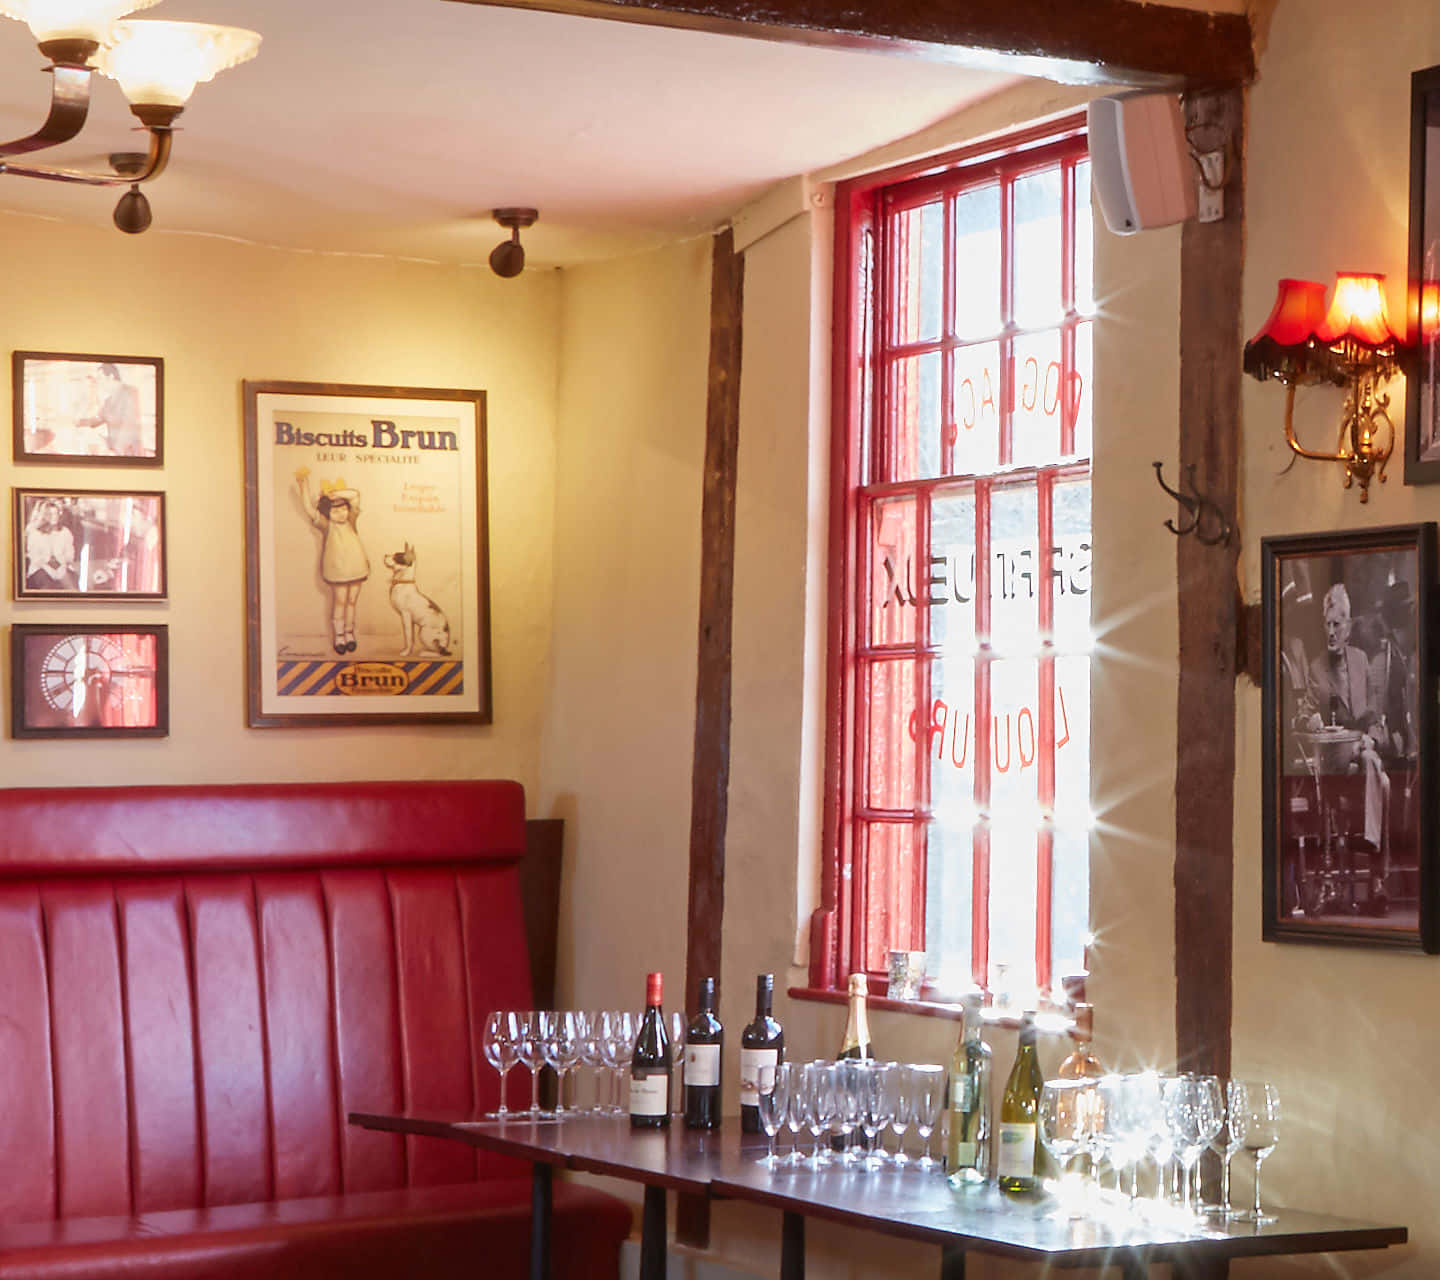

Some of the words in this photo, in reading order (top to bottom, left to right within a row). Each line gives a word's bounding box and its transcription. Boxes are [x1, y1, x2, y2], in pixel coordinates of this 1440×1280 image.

[274, 421, 368, 448] Biscuits
[371, 420, 459, 451] Brun
[340, 673, 405, 687] Brun
